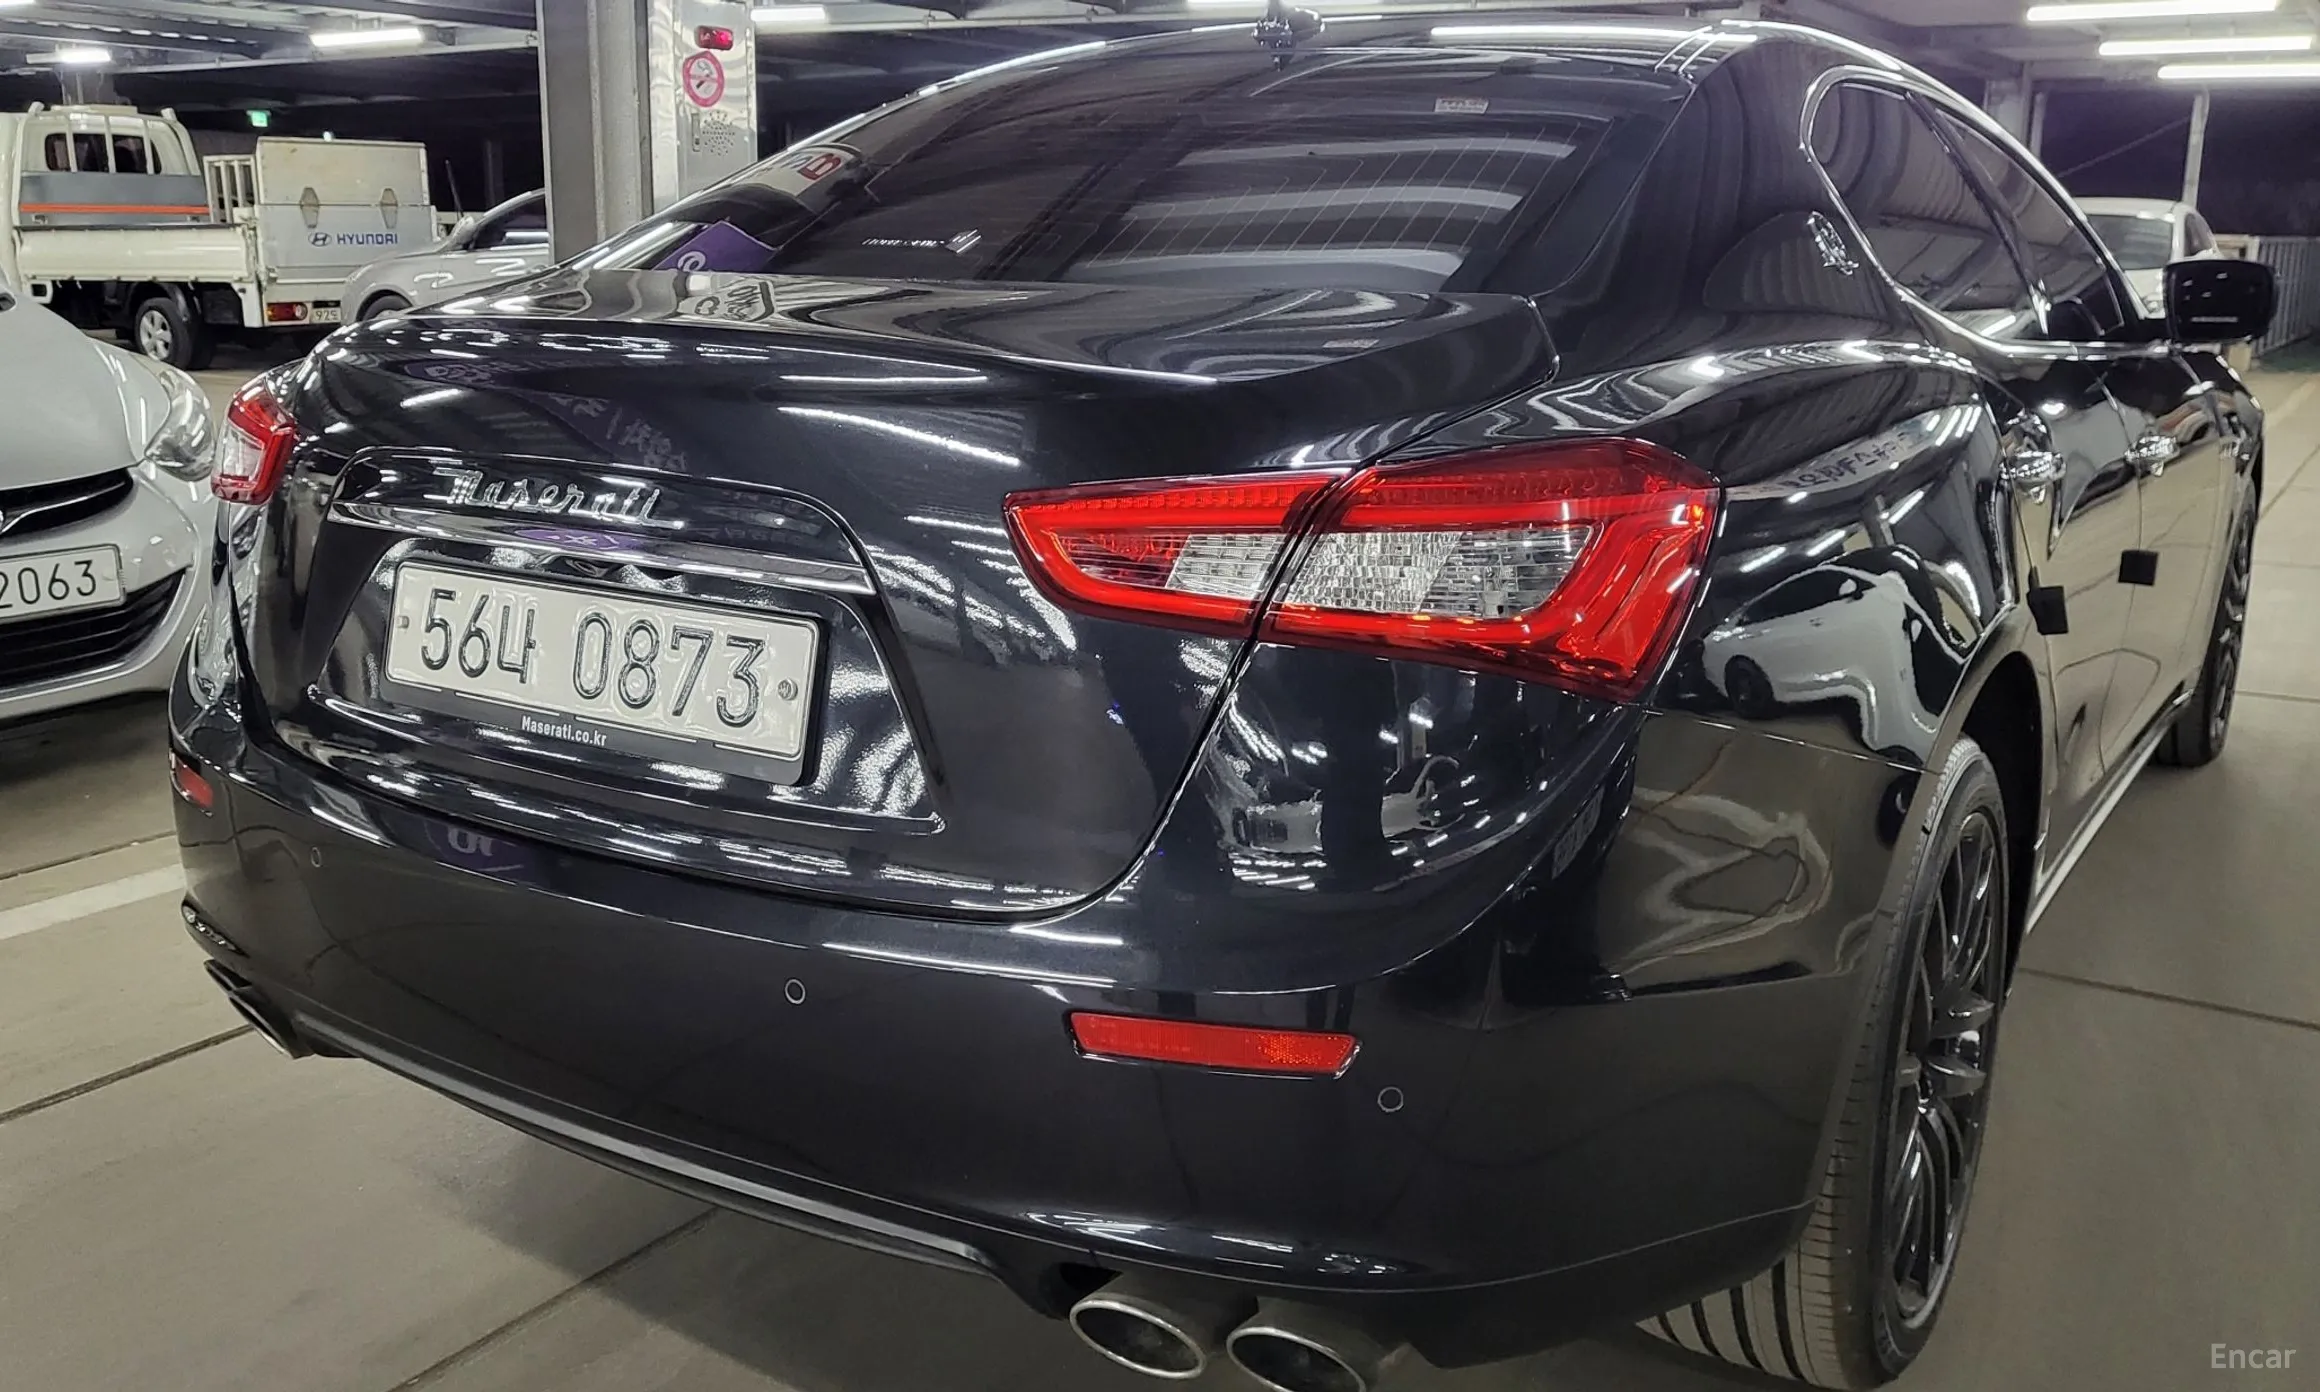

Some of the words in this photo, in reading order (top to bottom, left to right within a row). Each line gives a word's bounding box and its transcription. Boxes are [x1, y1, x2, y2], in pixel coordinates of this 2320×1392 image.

[336, 232, 399, 245] HYUNDAI
[423, 466, 685, 530] Maserati
[0, 559, 97, 609] 2063
[572, 610, 766, 729] 0873
[520, 714, 608, 747] Maserati.co.kr
